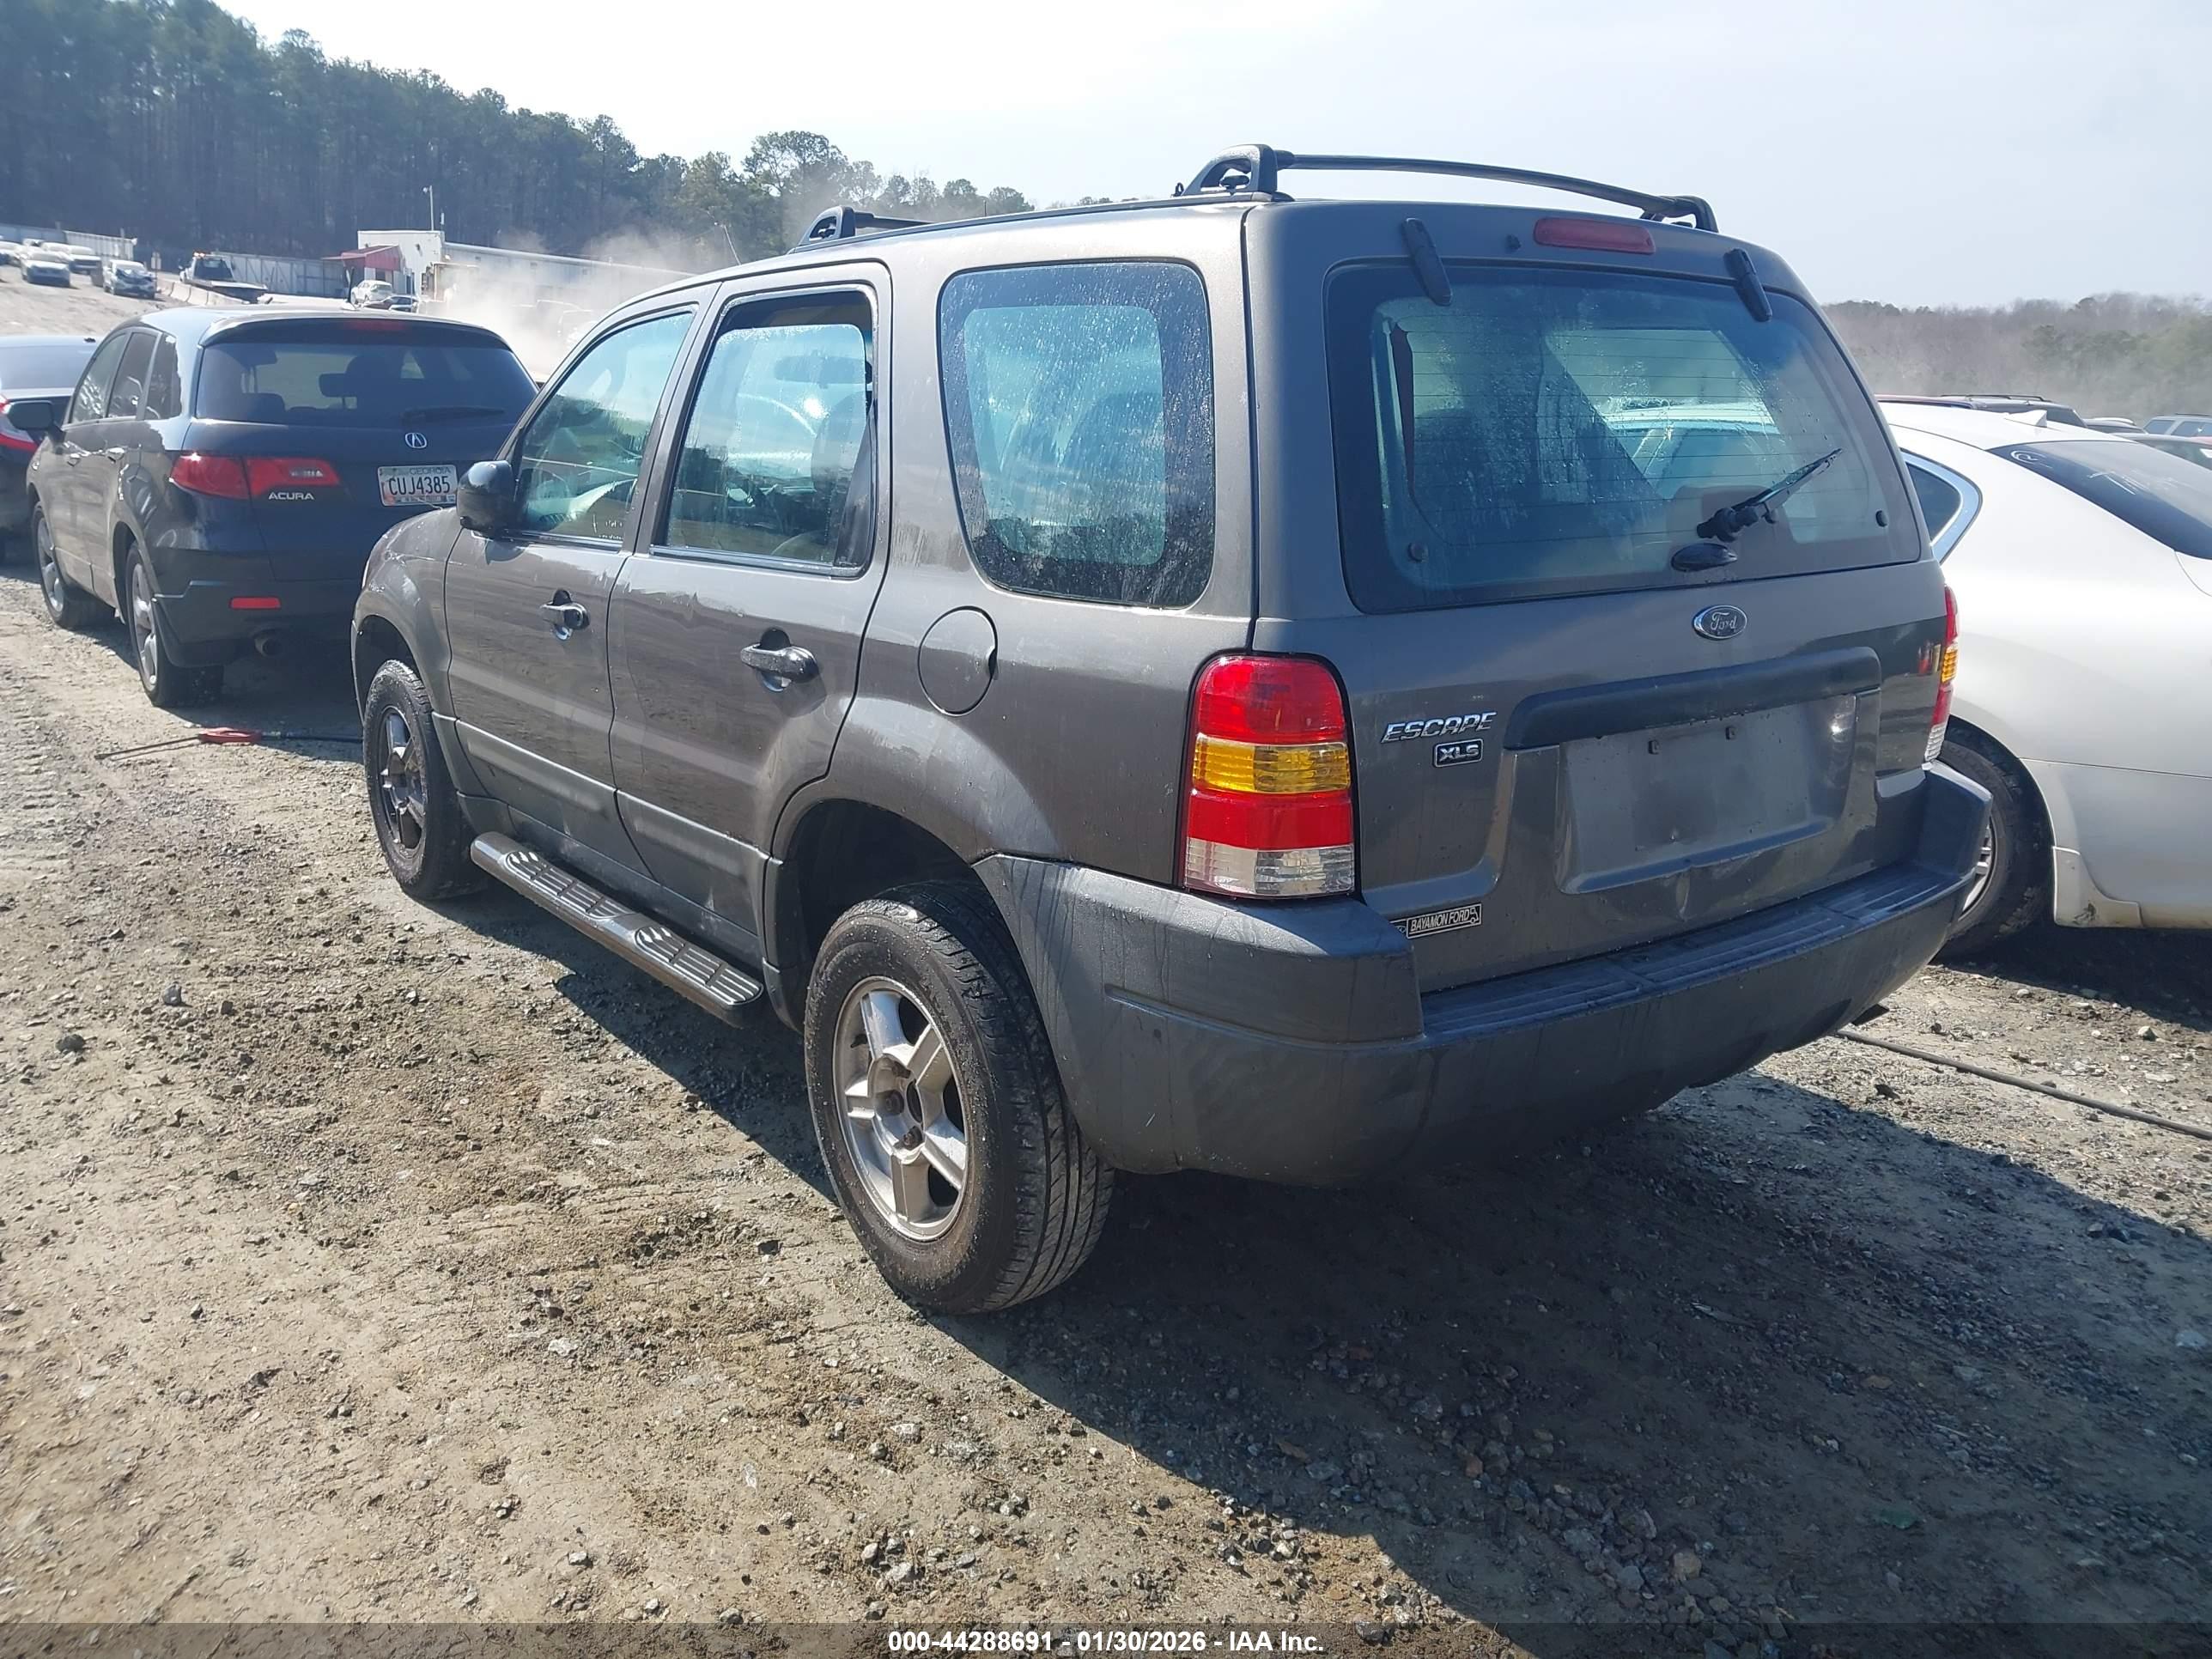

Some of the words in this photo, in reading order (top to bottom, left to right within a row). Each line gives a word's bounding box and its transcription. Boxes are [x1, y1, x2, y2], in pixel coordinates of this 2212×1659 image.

[388, 476, 451, 495] CUJ4385
[268, 491, 315, 501] ACURA
[1710, 611, 1737, 631] Ford
[1381, 712, 1497, 744] ESCAPE
[1439, 744, 1480, 762] XLS
[1410, 912, 1449, 932] BAYAMON
[1449, 908, 1470, 924] FORD
